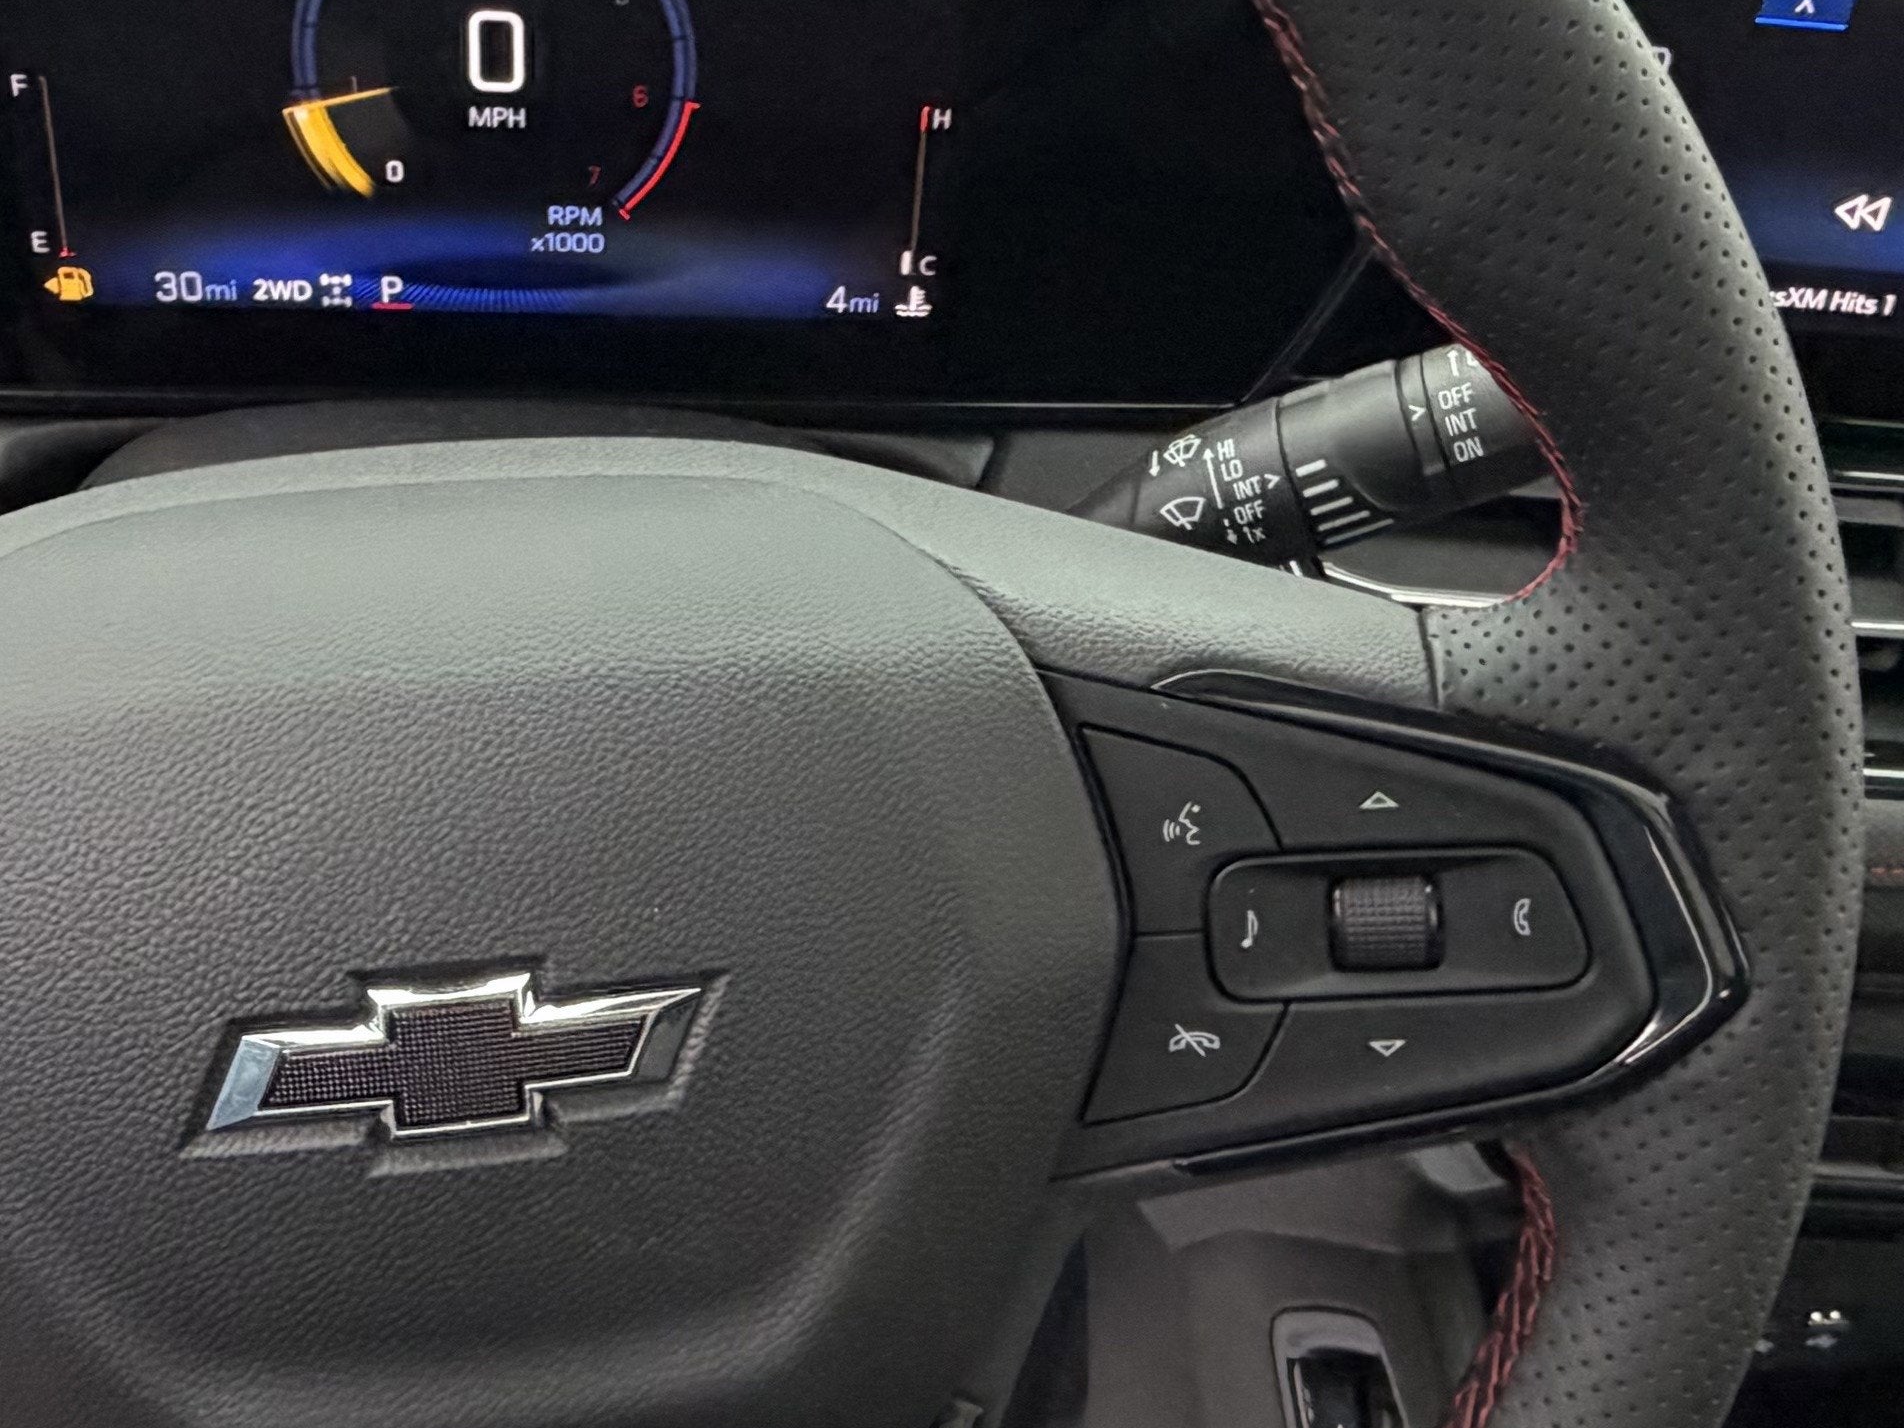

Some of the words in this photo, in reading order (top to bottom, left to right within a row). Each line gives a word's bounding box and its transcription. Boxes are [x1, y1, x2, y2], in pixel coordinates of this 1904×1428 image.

[468, 10, 525, 92] 0
[10, 73, 28, 97] F
[632, 84, 649, 108] 6
[468, 106, 527, 128] MPH
[932, 108, 952, 130] H
[385, 160, 405, 183] 0
[588, 165, 601, 187] 7
[547, 205, 602, 226] RPM
[30, 230, 50, 254] E
[530, 232, 605, 254] x1000
[919, 255, 937, 276] C
[252, 278, 313, 302] 2WD
[380, 275, 404, 303] P
[1829, 290, 1878, 314] Hits
[1882, 293, 1896, 316] 1
[1438, 384, 1473, 410] OFF
[1445, 409, 1477, 436] INT
[1218, 440, 1235, 461] HI
[1453, 437, 1484, 463] ON
[1221, 461, 1244, 482] LO
[1234, 476, 1263, 499] INT
[1234, 501, 1264, 525] OFF
